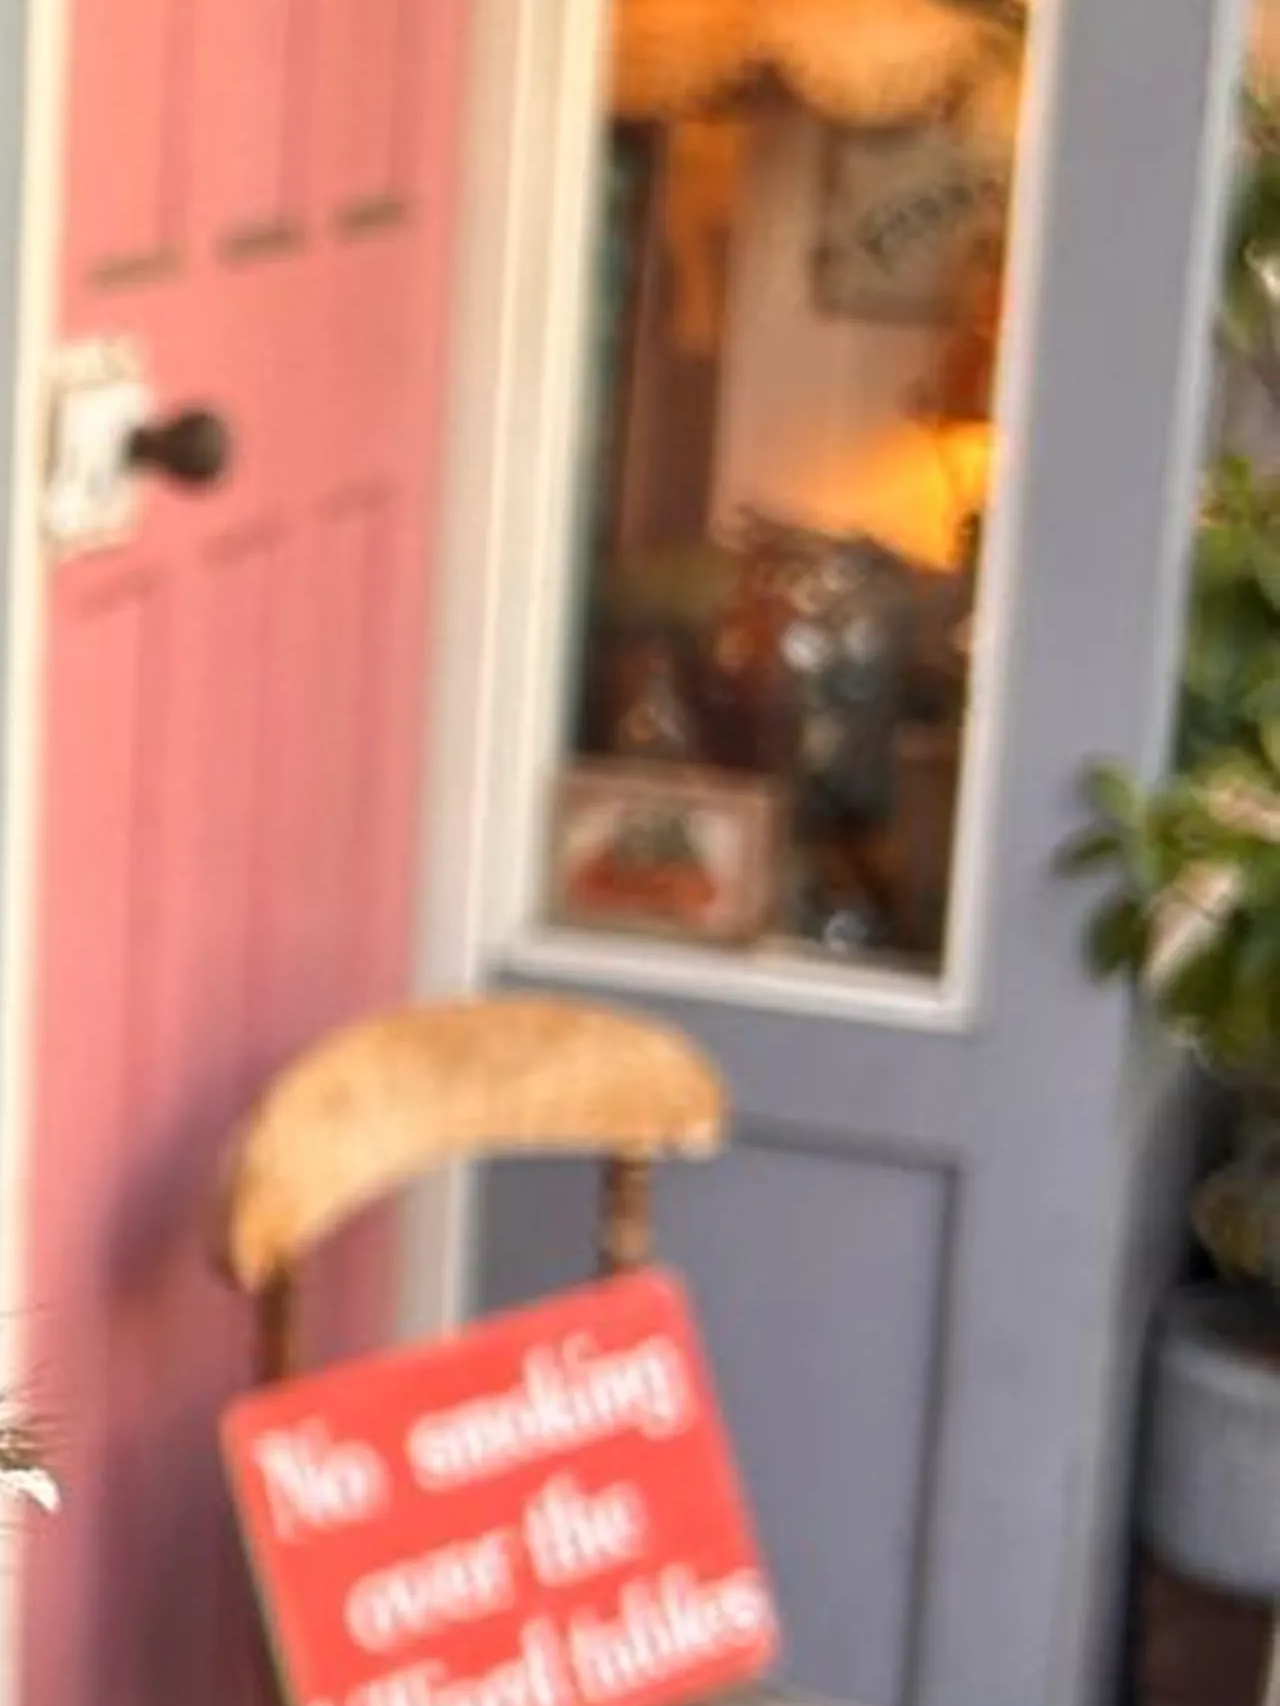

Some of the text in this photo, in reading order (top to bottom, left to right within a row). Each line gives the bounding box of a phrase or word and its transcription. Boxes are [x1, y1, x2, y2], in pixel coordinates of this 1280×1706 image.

[254, 1331, 688, 1540] No smoking
[348, 1475, 645, 1651] over the
